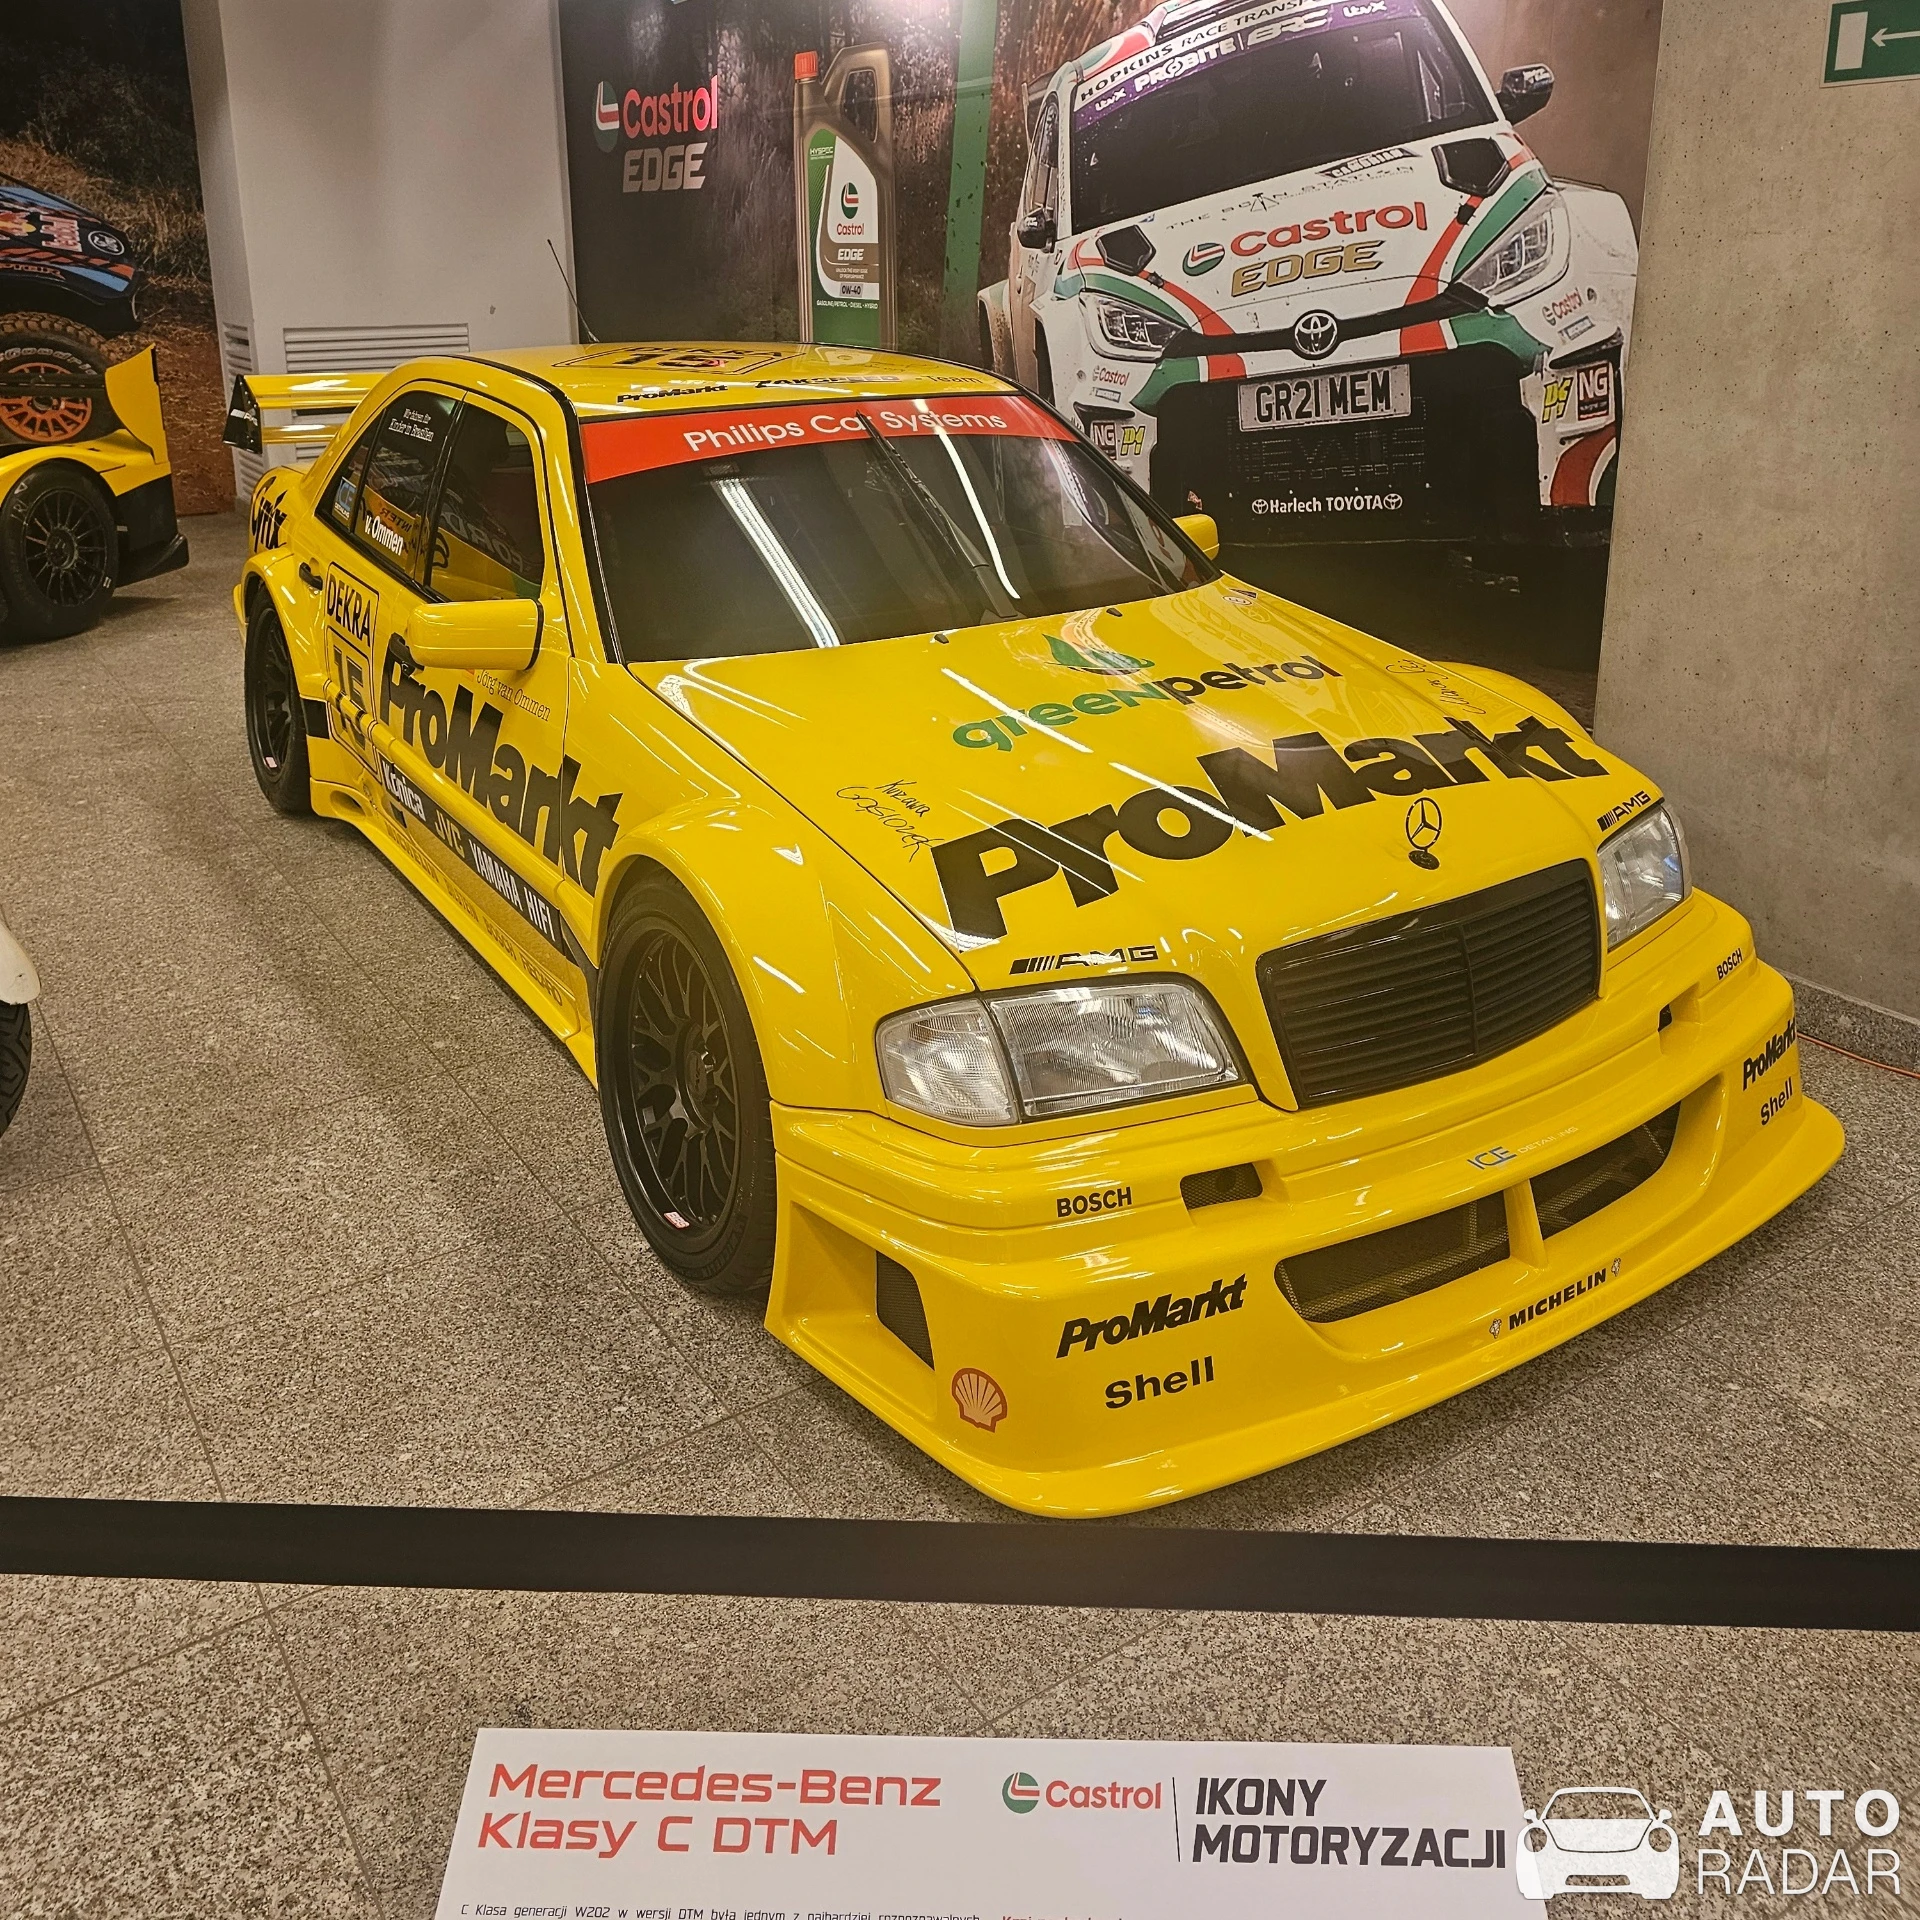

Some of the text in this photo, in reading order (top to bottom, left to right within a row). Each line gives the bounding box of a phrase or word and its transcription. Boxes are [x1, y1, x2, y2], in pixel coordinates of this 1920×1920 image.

[1080, 43, 1174, 102] HOPKINS
[1181, 22, 1229, 50] RACE
[1134, 39, 1237, 93] PROBITE
[623, 75, 718, 139] Castrol
[622, 142, 708, 193] EDGE
[836, 223, 865, 236] Castrol
[1231, 201, 1428, 257] Castrol
[837, 248, 865, 261] EDGE
[1231, 239, 1386, 297] EDGE
[841, 285, 862, 295] 0W-40
[1552, 287, 1583, 319] Castrol
[617, 384, 728, 404] ProMarkt
[1099, 367, 1131, 387] Castrol
[1255, 369, 1392, 423] GR21 MEM
[1580, 366, 1608, 401] NG
[683, 419, 805, 452] Philips
[880, 410, 1008, 433] Systems
[1093, 424, 1116, 446] NG
[1270, 494, 1385, 514] Harlech TOYOTA
[371, 515, 405, 556] Ommen
[326, 573, 372, 648] DEKRA
[476, 668, 551, 722] Jörg van Ommen
[952, 655, 1343, 753] greenpetrol
[380, 644, 624, 899] ProMarkt
[1613, 791, 1651, 822] AMG
[381, 760, 427, 822] Konica
[433, 809, 466, 858] JVC
[468, 839, 524, 912] YAMAHA
[523, 886, 557, 942] HIFI
[930, 715, 1610, 951] ProMarkt
[1716, 947, 1743, 981] BOSCH
[1760, 1076, 1794, 1126] Shell
[1466, 1146, 1518, 1171] ICE
[1056, 1186, 1133, 1218] BOSCH
[1055, 1273, 1248, 1359] ProMarkt
[1508, 1267, 1608, 1331] MICHELIN
[1104, 1355, 1215, 1410] Shell
[488, 1763, 942, 1807] Mercedes-Benz
[1045, 1779, 1162, 1810] Castrol
[1195, 1776, 1328, 1817] IKONY
[477, 1810, 838, 1859] Klasy C DTM
[1191, 1823, 1507, 1869] MOTORYZACJI
[461, 1904, 470, 1915] C
[475, 1904, 507, 1916] Klasa
[514, 1905, 567, 1919] generacji
[575, 1906, 611, 1918] W202
[618, 1908, 628, 1918] w
[635, 1907, 672, 1920] wersji
[678, 1908, 704, 1920] DTM
[710, 1908, 737, 1920] była
